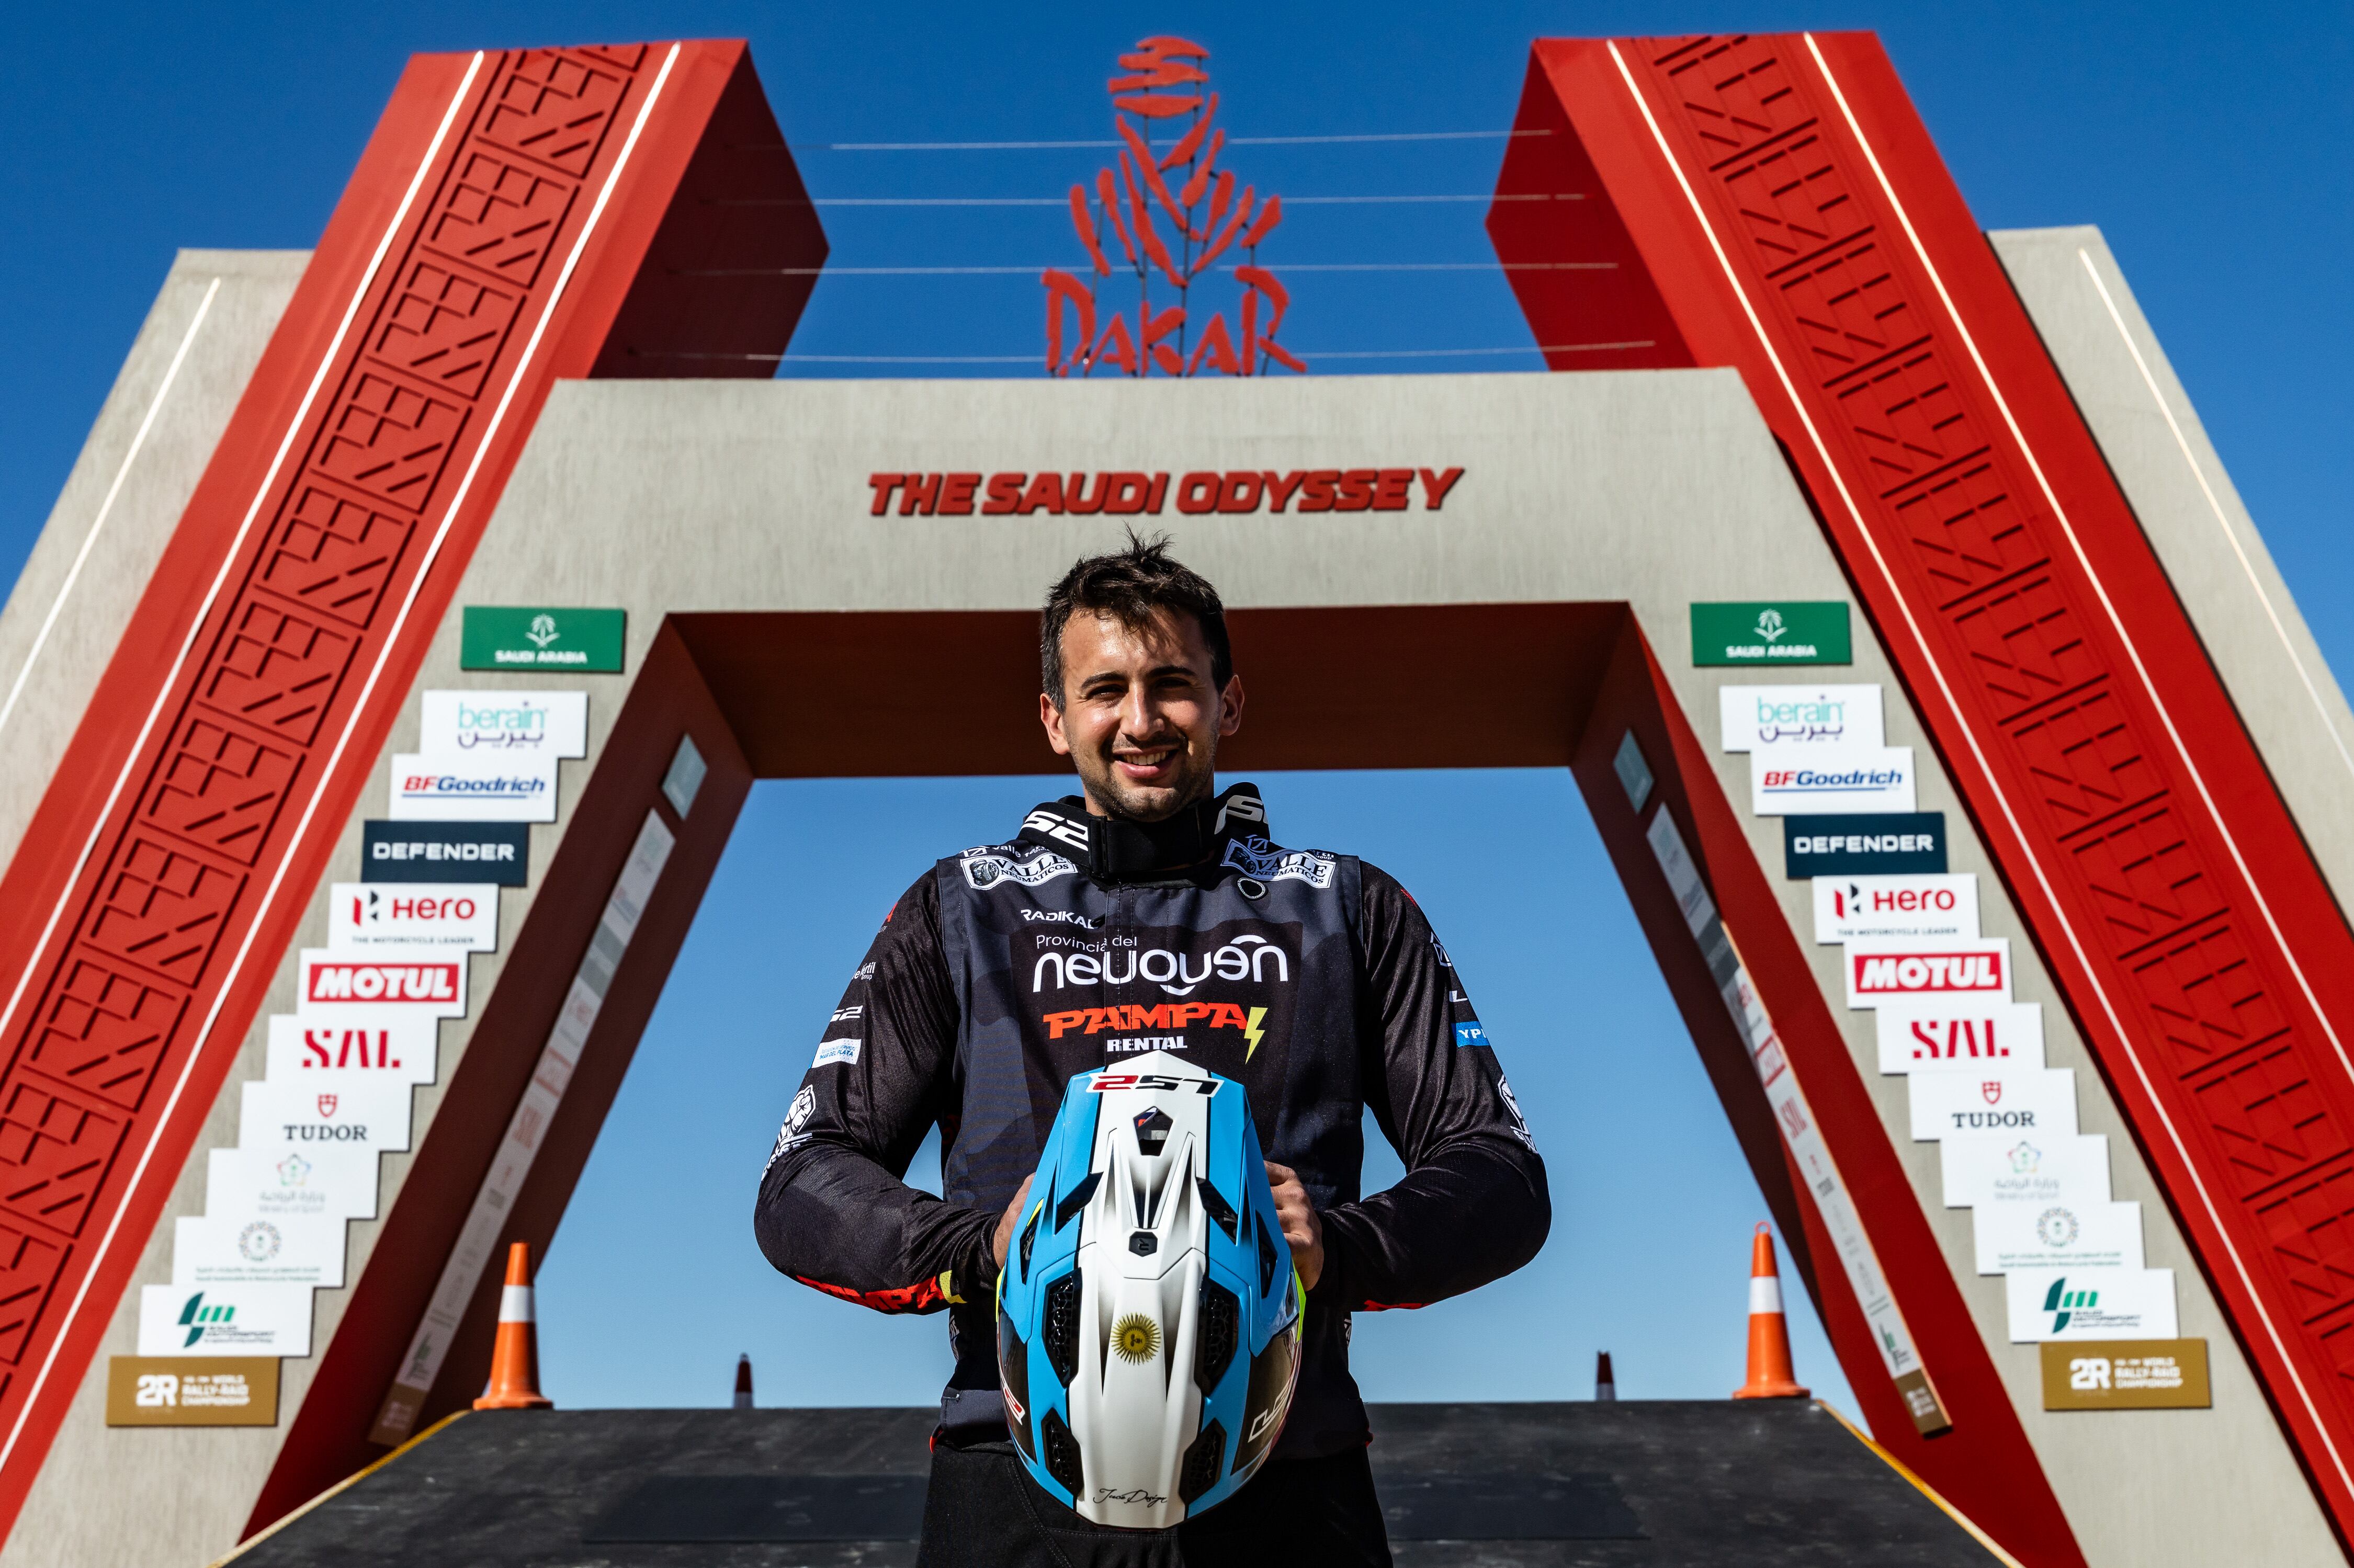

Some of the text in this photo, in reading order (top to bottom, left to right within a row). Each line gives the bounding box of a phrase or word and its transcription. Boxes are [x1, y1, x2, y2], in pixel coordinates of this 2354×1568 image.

[1041, 265, 1306, 377] DAKAR
[868, 468, 1466, 516] THE SAUDI ODYSSEY
[494, 650, 587, 664] SAUDI ARABIA
[1726, 645, 1817, 658] SAUDI ARABIA
[458, 701, 545, 730] berain
[1757, 695, 1844, 723] berain
[403, 776, 545, 793] BFGoodrich
[1763, 769, 1902, 787] BFGoodrich
[372, 842, 515, 861] DEFENDER
[1794, 834, 1934, 854] DEFENDER
[992, 855, 1067, 877] VALLE
[1000, 864, 1069, 883] NEUMATICOS
[1255, 853, 1327, 878] VALLE
[1255, 866, 1324, 884] NEUMATICOS
[392, 898, 476, 919] Hero
[1873, 889, 1955, 912] Hero
[1021, 908, 1096, 929] RADIKAL
[1036, 934, 1138, 953] Provincia del
[313, 967, 454, 999] MOTUL
[1860, 956, 1997, 990] MOTUL
[1043, 1002, 1249, 1040] PAMPA
[837, 1049, 854, 1058] PLATA
[1106, 1036, 1188, 1052] RENTAL
[1951, 1110, 2035, 1128] TUDOR
[283, 1124, 367, 1141] TUDOR
